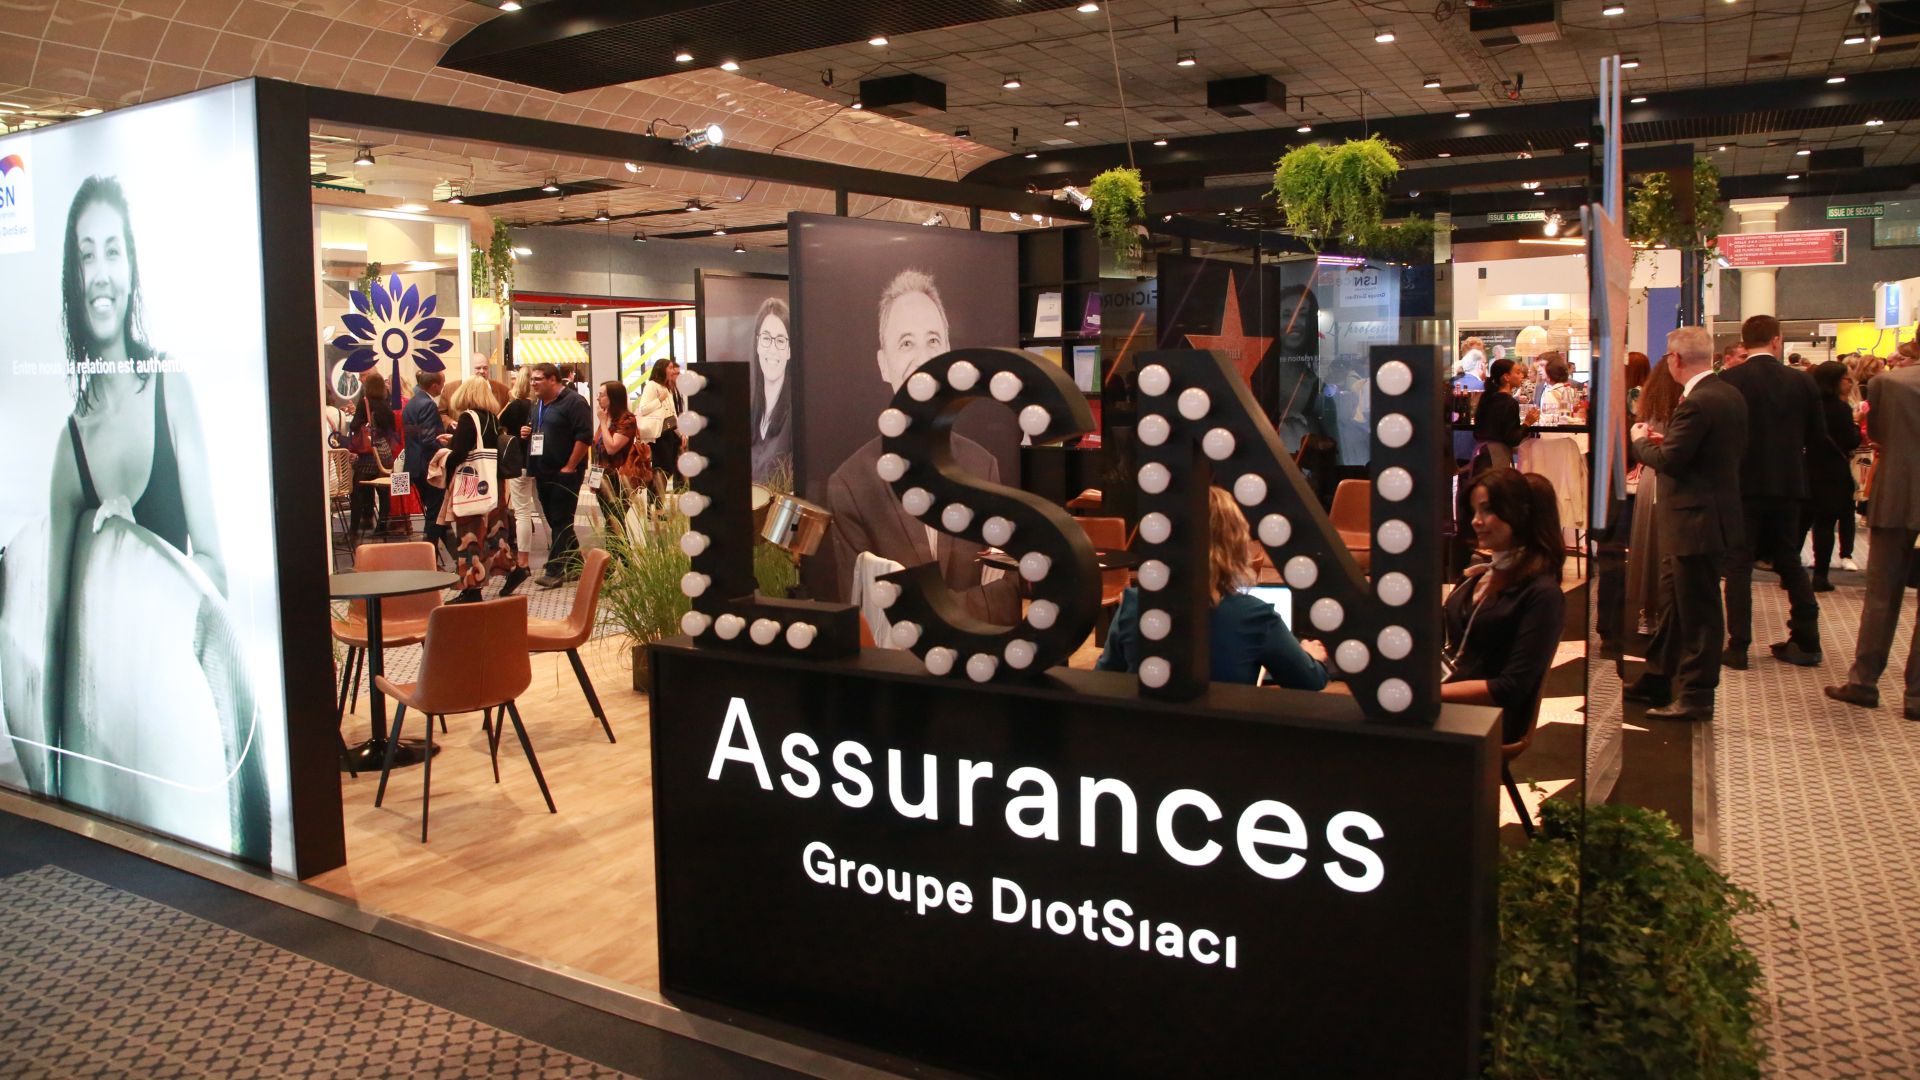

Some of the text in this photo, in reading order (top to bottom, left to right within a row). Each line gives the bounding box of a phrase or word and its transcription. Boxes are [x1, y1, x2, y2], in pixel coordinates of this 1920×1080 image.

[1488, 213, 1505, 221] ISSUE
[1828, 206, 1884, 217] ISSUE DE SECOURS
[77, 356, 115, 375] relation
[117, 357, 134, 374] est
[678, 345, 1443, 728] LSN
[708, 697, 1384, 893] Assurances
[803, 842, 973, 916] Groupe
